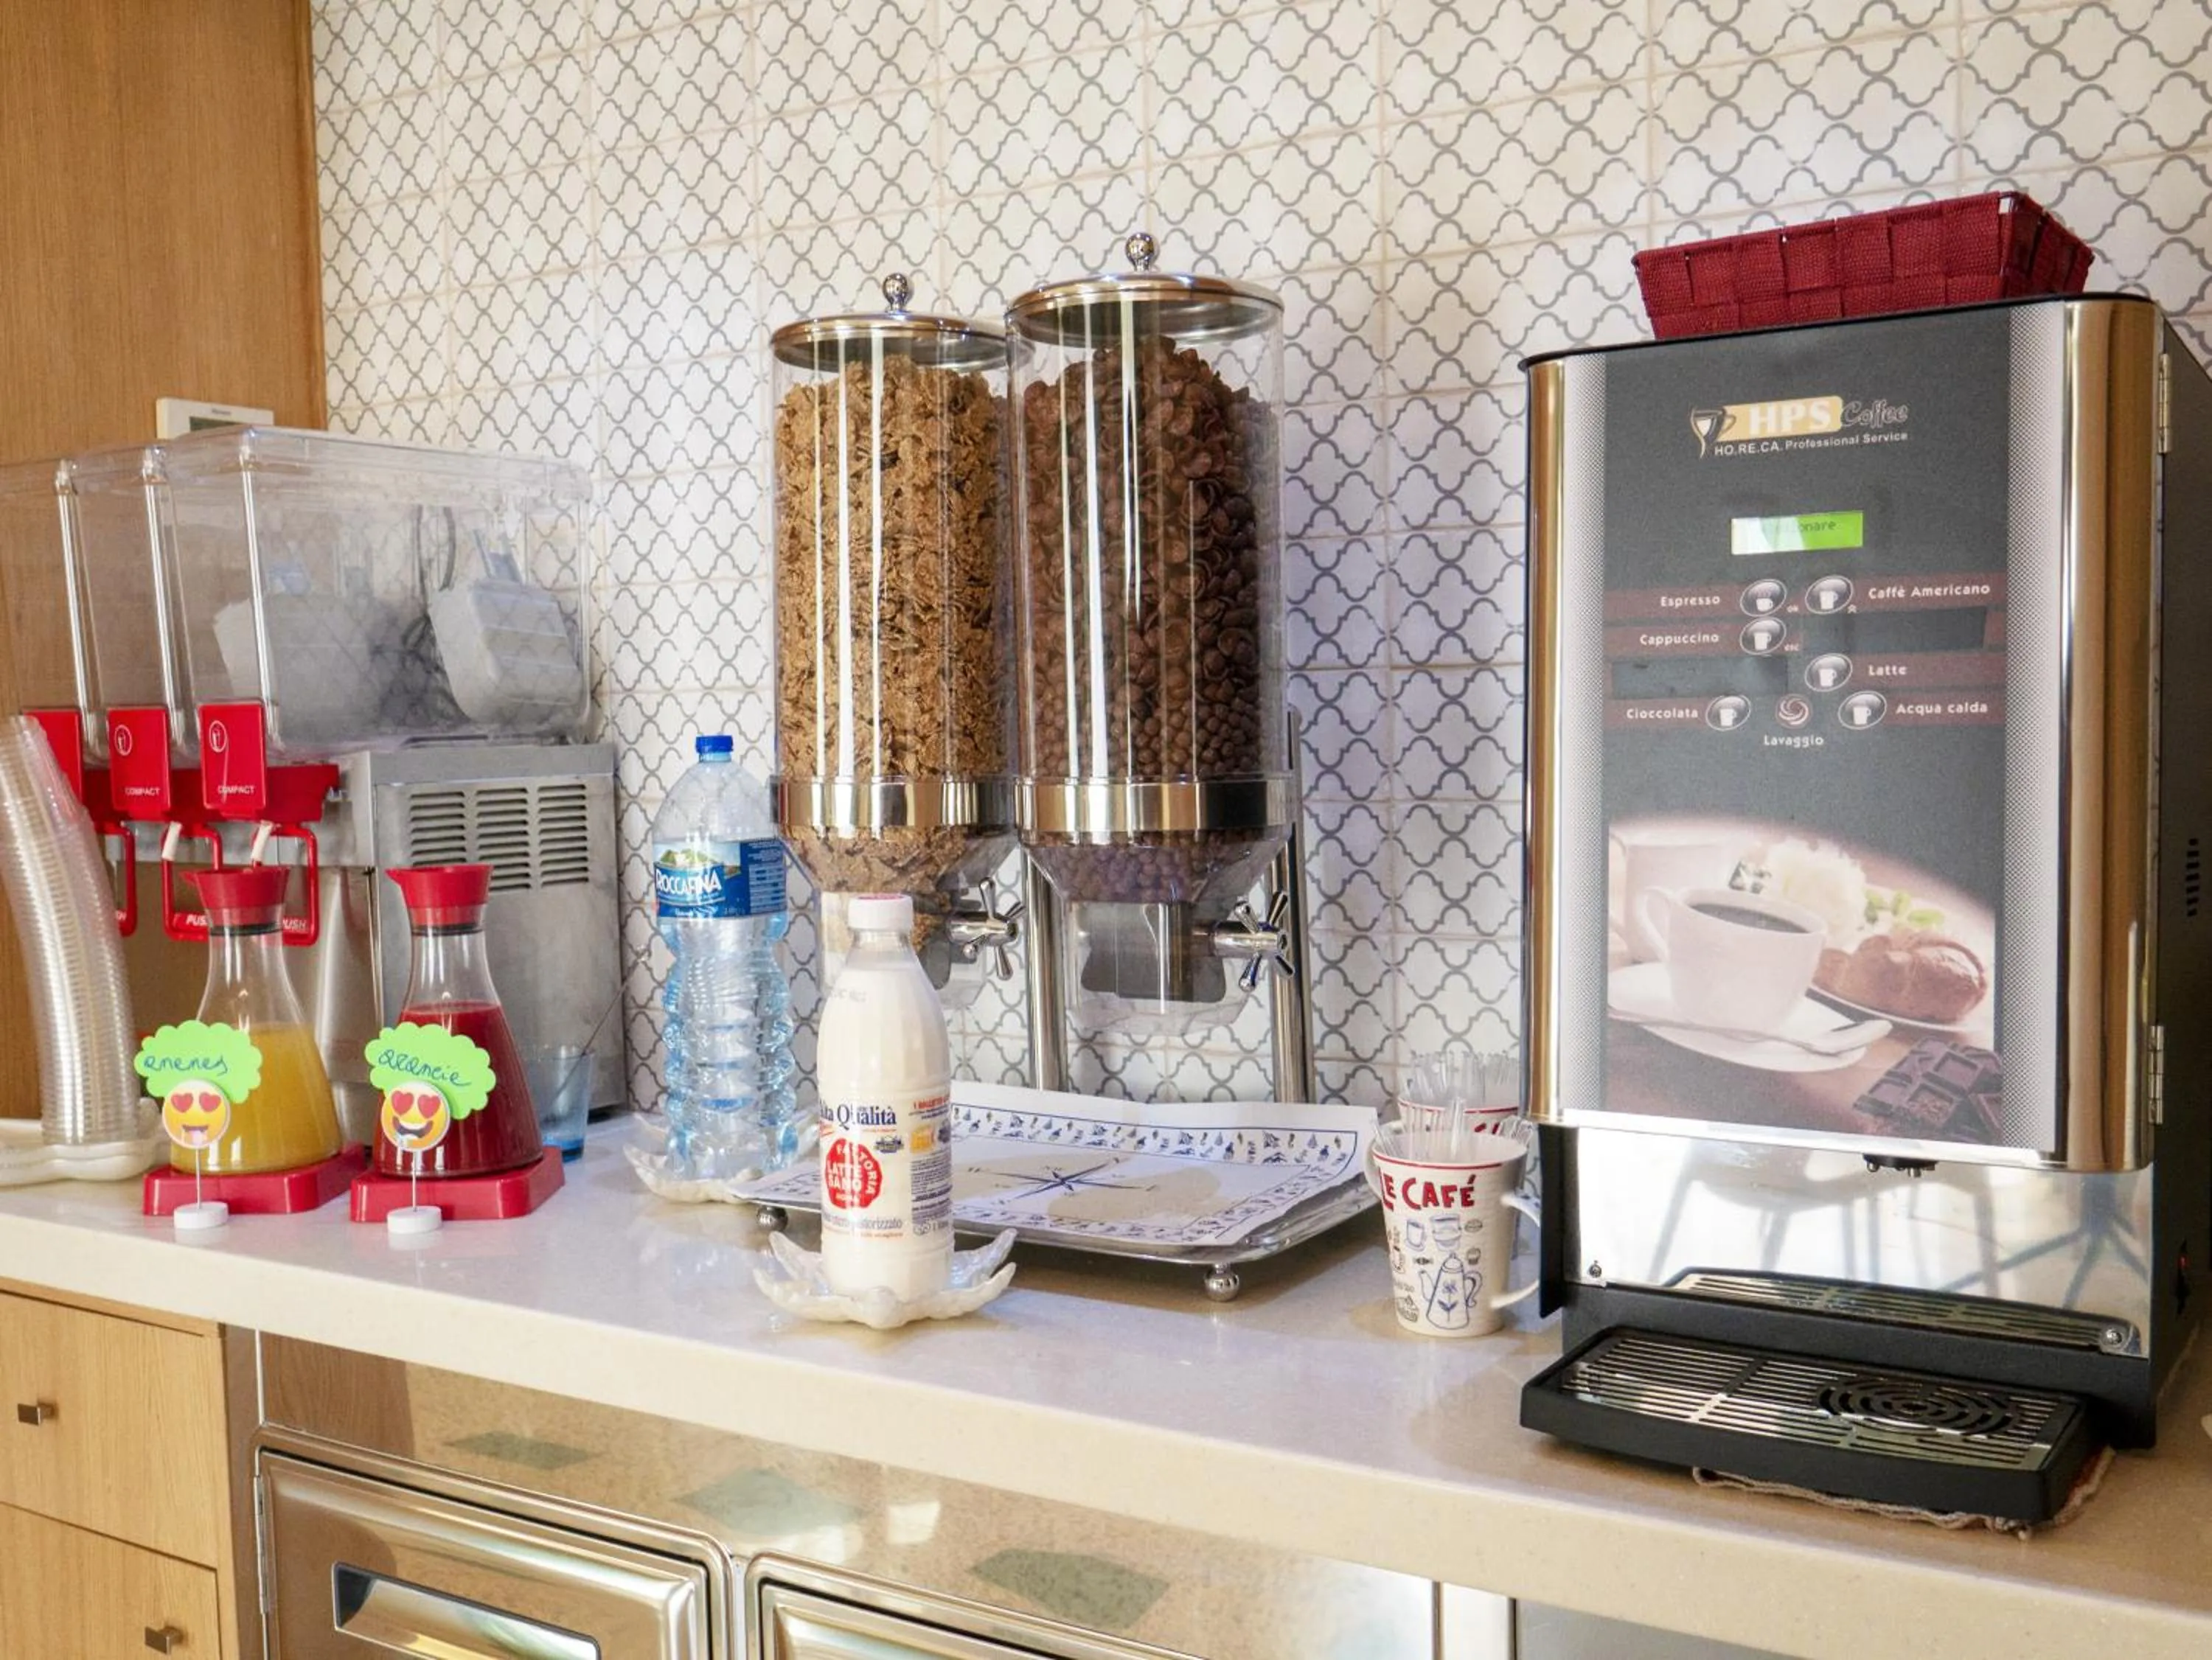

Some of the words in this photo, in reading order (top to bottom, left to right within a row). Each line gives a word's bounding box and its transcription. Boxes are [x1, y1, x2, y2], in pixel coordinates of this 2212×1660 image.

[1749, 399, 1832, 435] HPS
[1841, 399, 1908, 429] Coffee
[1785, 433, 1860, 450] Professional
[1863, 431, 1908, 444] Service
[1911, 584, 1991, 598] Americano
[1660, 596, 1721, 609] Espresso
[1639, 631, 1720, 646] Cappuccino
[1868, 664, 1907, 676] Latte
[1626, 708, 1699, 719] Cioccolata
[1896, 703, 1942, 716] Acqua
[1947, 701, 1989, 714] calda
[1764, 735, 1825, 748] Lavaggio
[218, 784, 255, 795] COMPACT
[186, 913, 208, 926] PUS
[1402, 1173, 1477, 1210] CAFÉ
